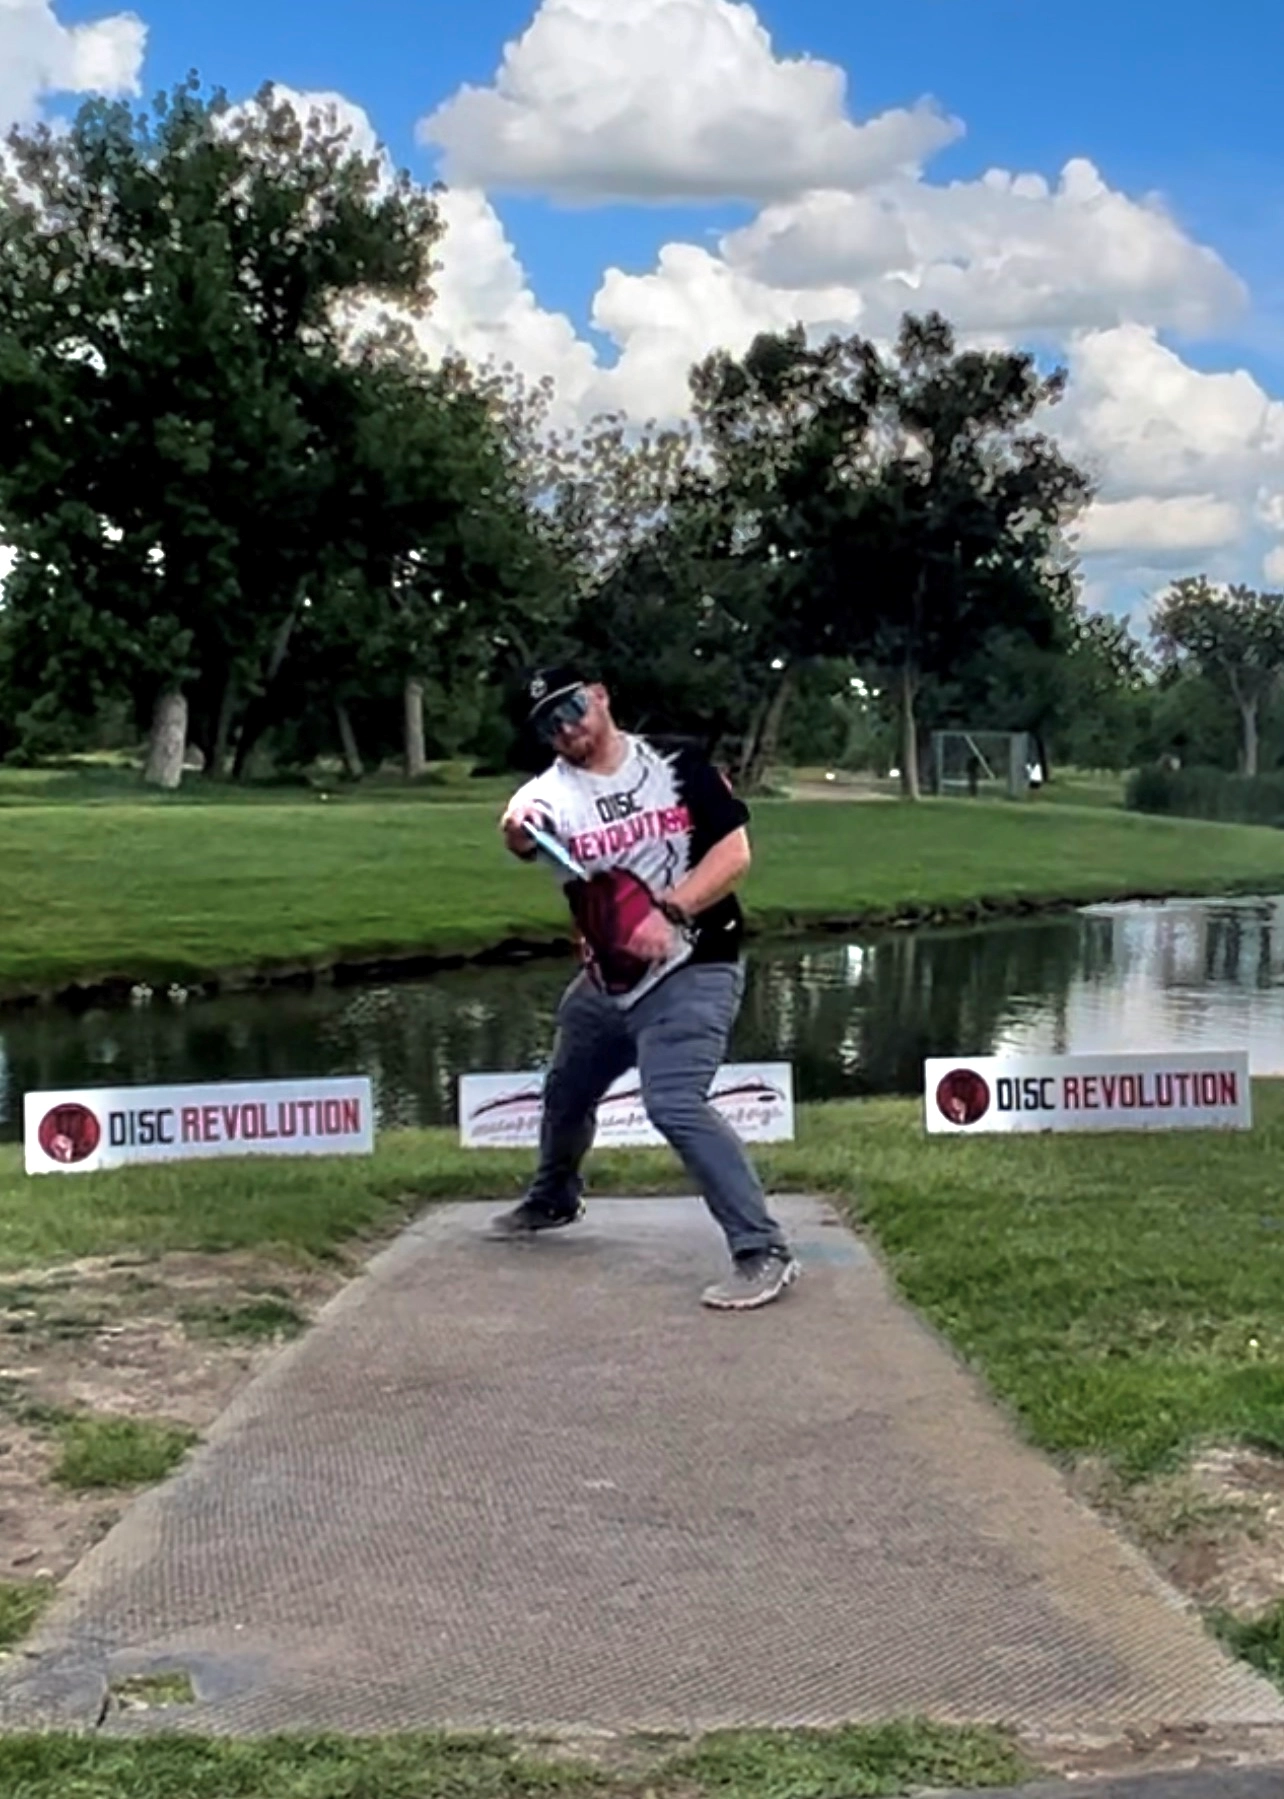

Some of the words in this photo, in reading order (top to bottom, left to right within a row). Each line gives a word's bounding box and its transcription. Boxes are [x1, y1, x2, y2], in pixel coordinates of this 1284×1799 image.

[596, 792, 643, 823] DISC
[996, 1078, 1055, 1111] DISC
[1063, 1073, 1238, 1109] REVOLUTION
[109, 1109, 173, 1146] DISC
[181, 1099, 361, 1143] REVOLUTION
